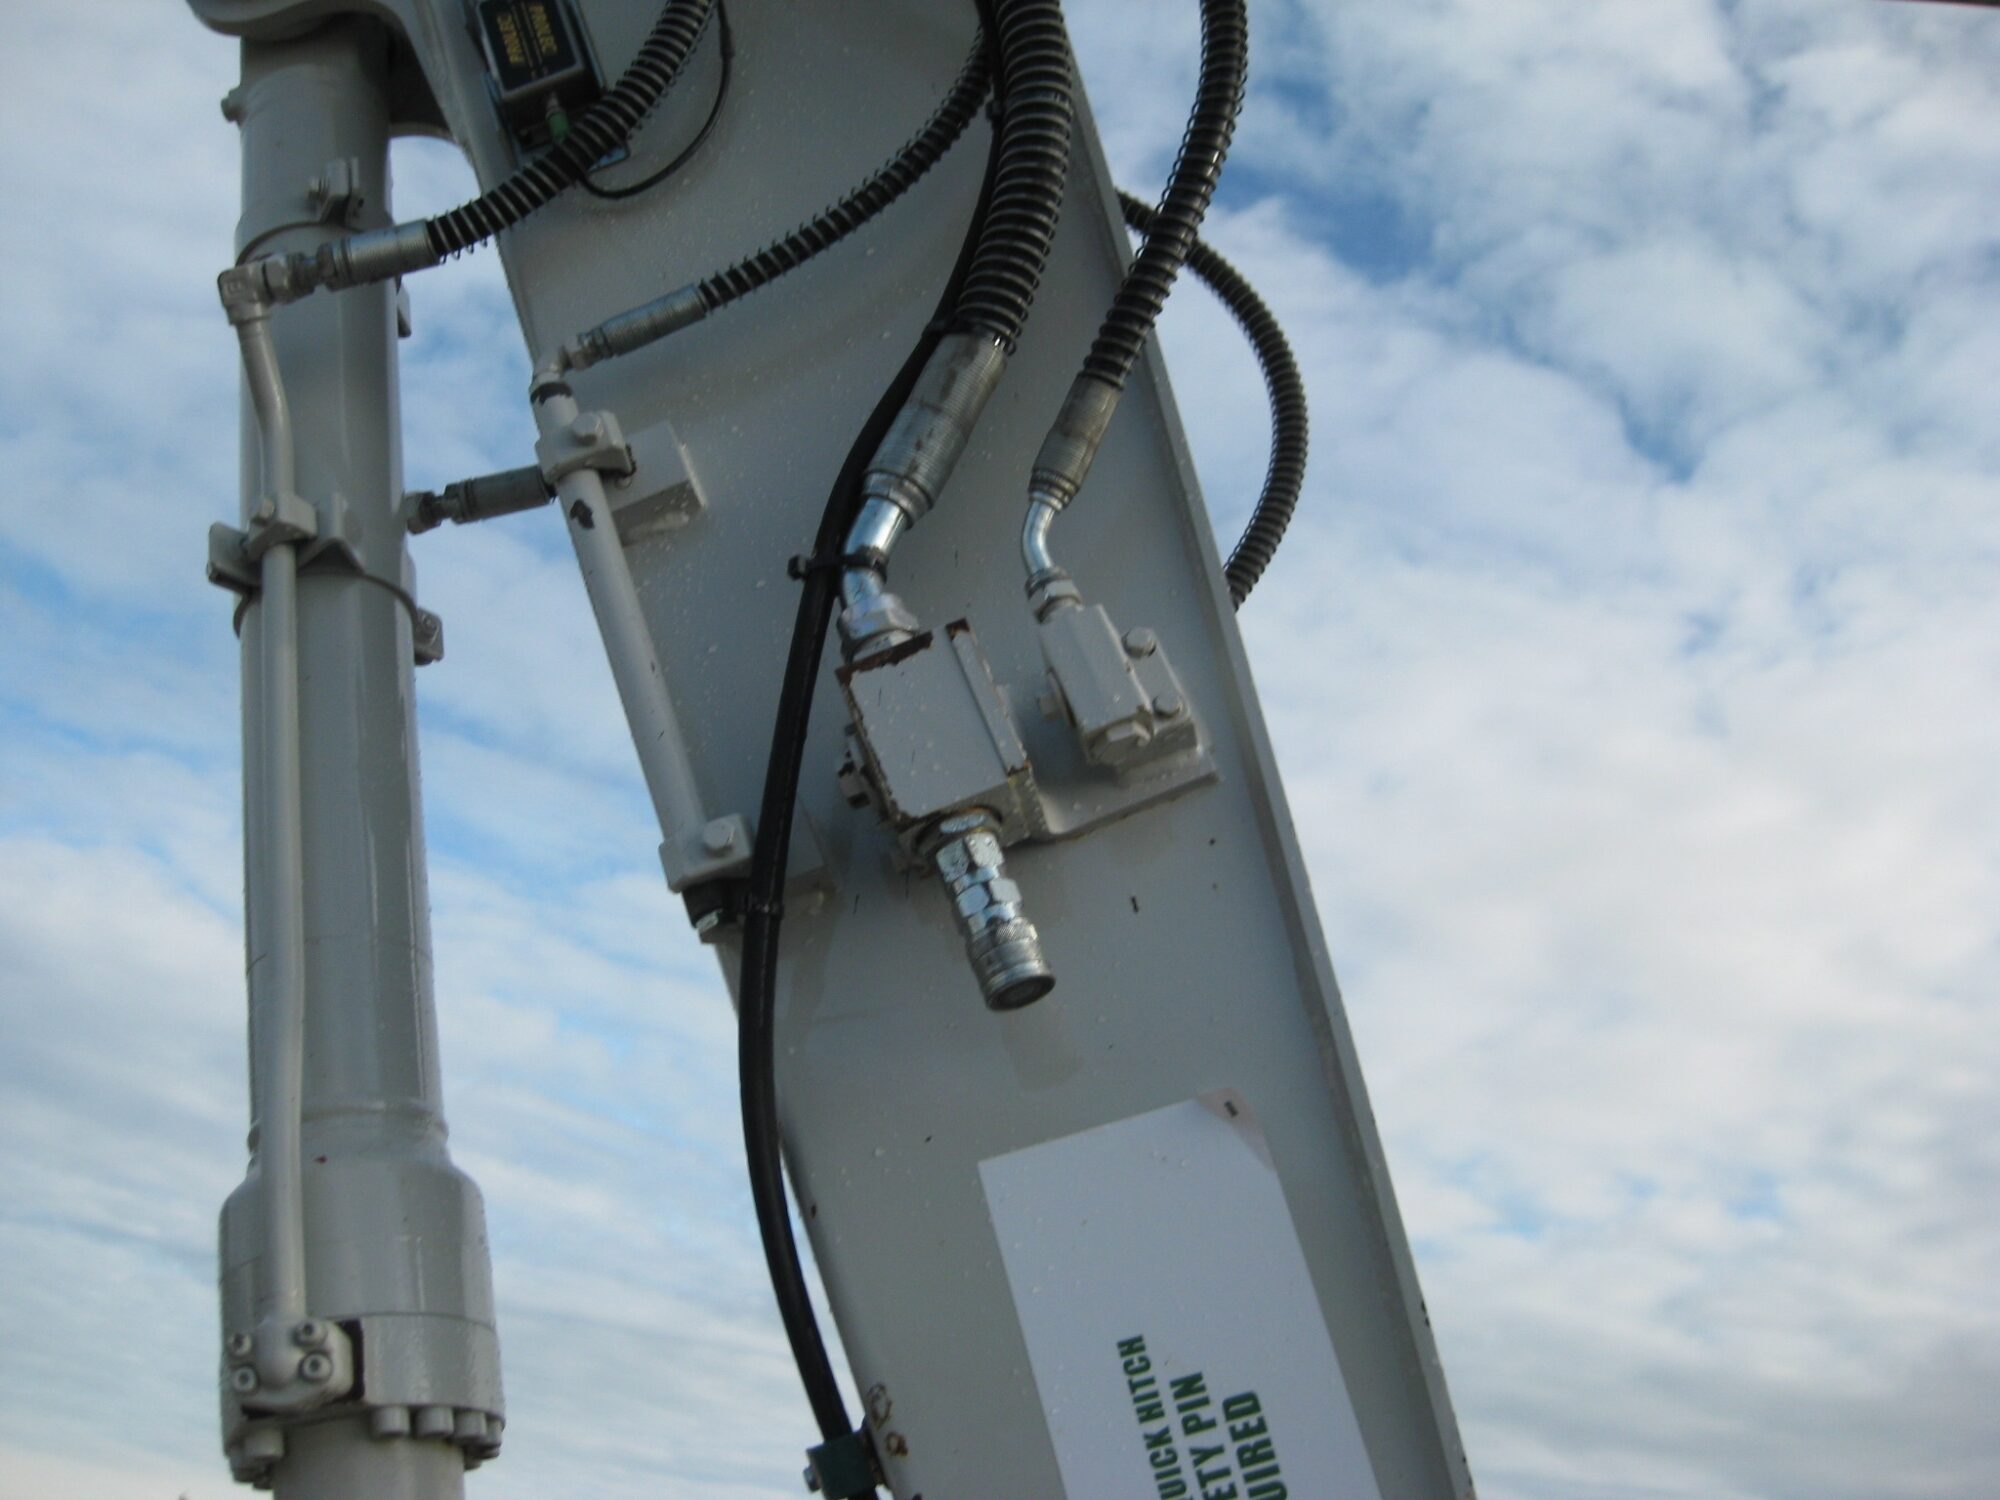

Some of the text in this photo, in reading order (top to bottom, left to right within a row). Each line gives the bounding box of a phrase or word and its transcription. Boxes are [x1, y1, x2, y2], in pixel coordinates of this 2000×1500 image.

[1116, 1335, 1193, 1500] UICK HITCH
[1169, 1371, 1217, 1436] PIN
